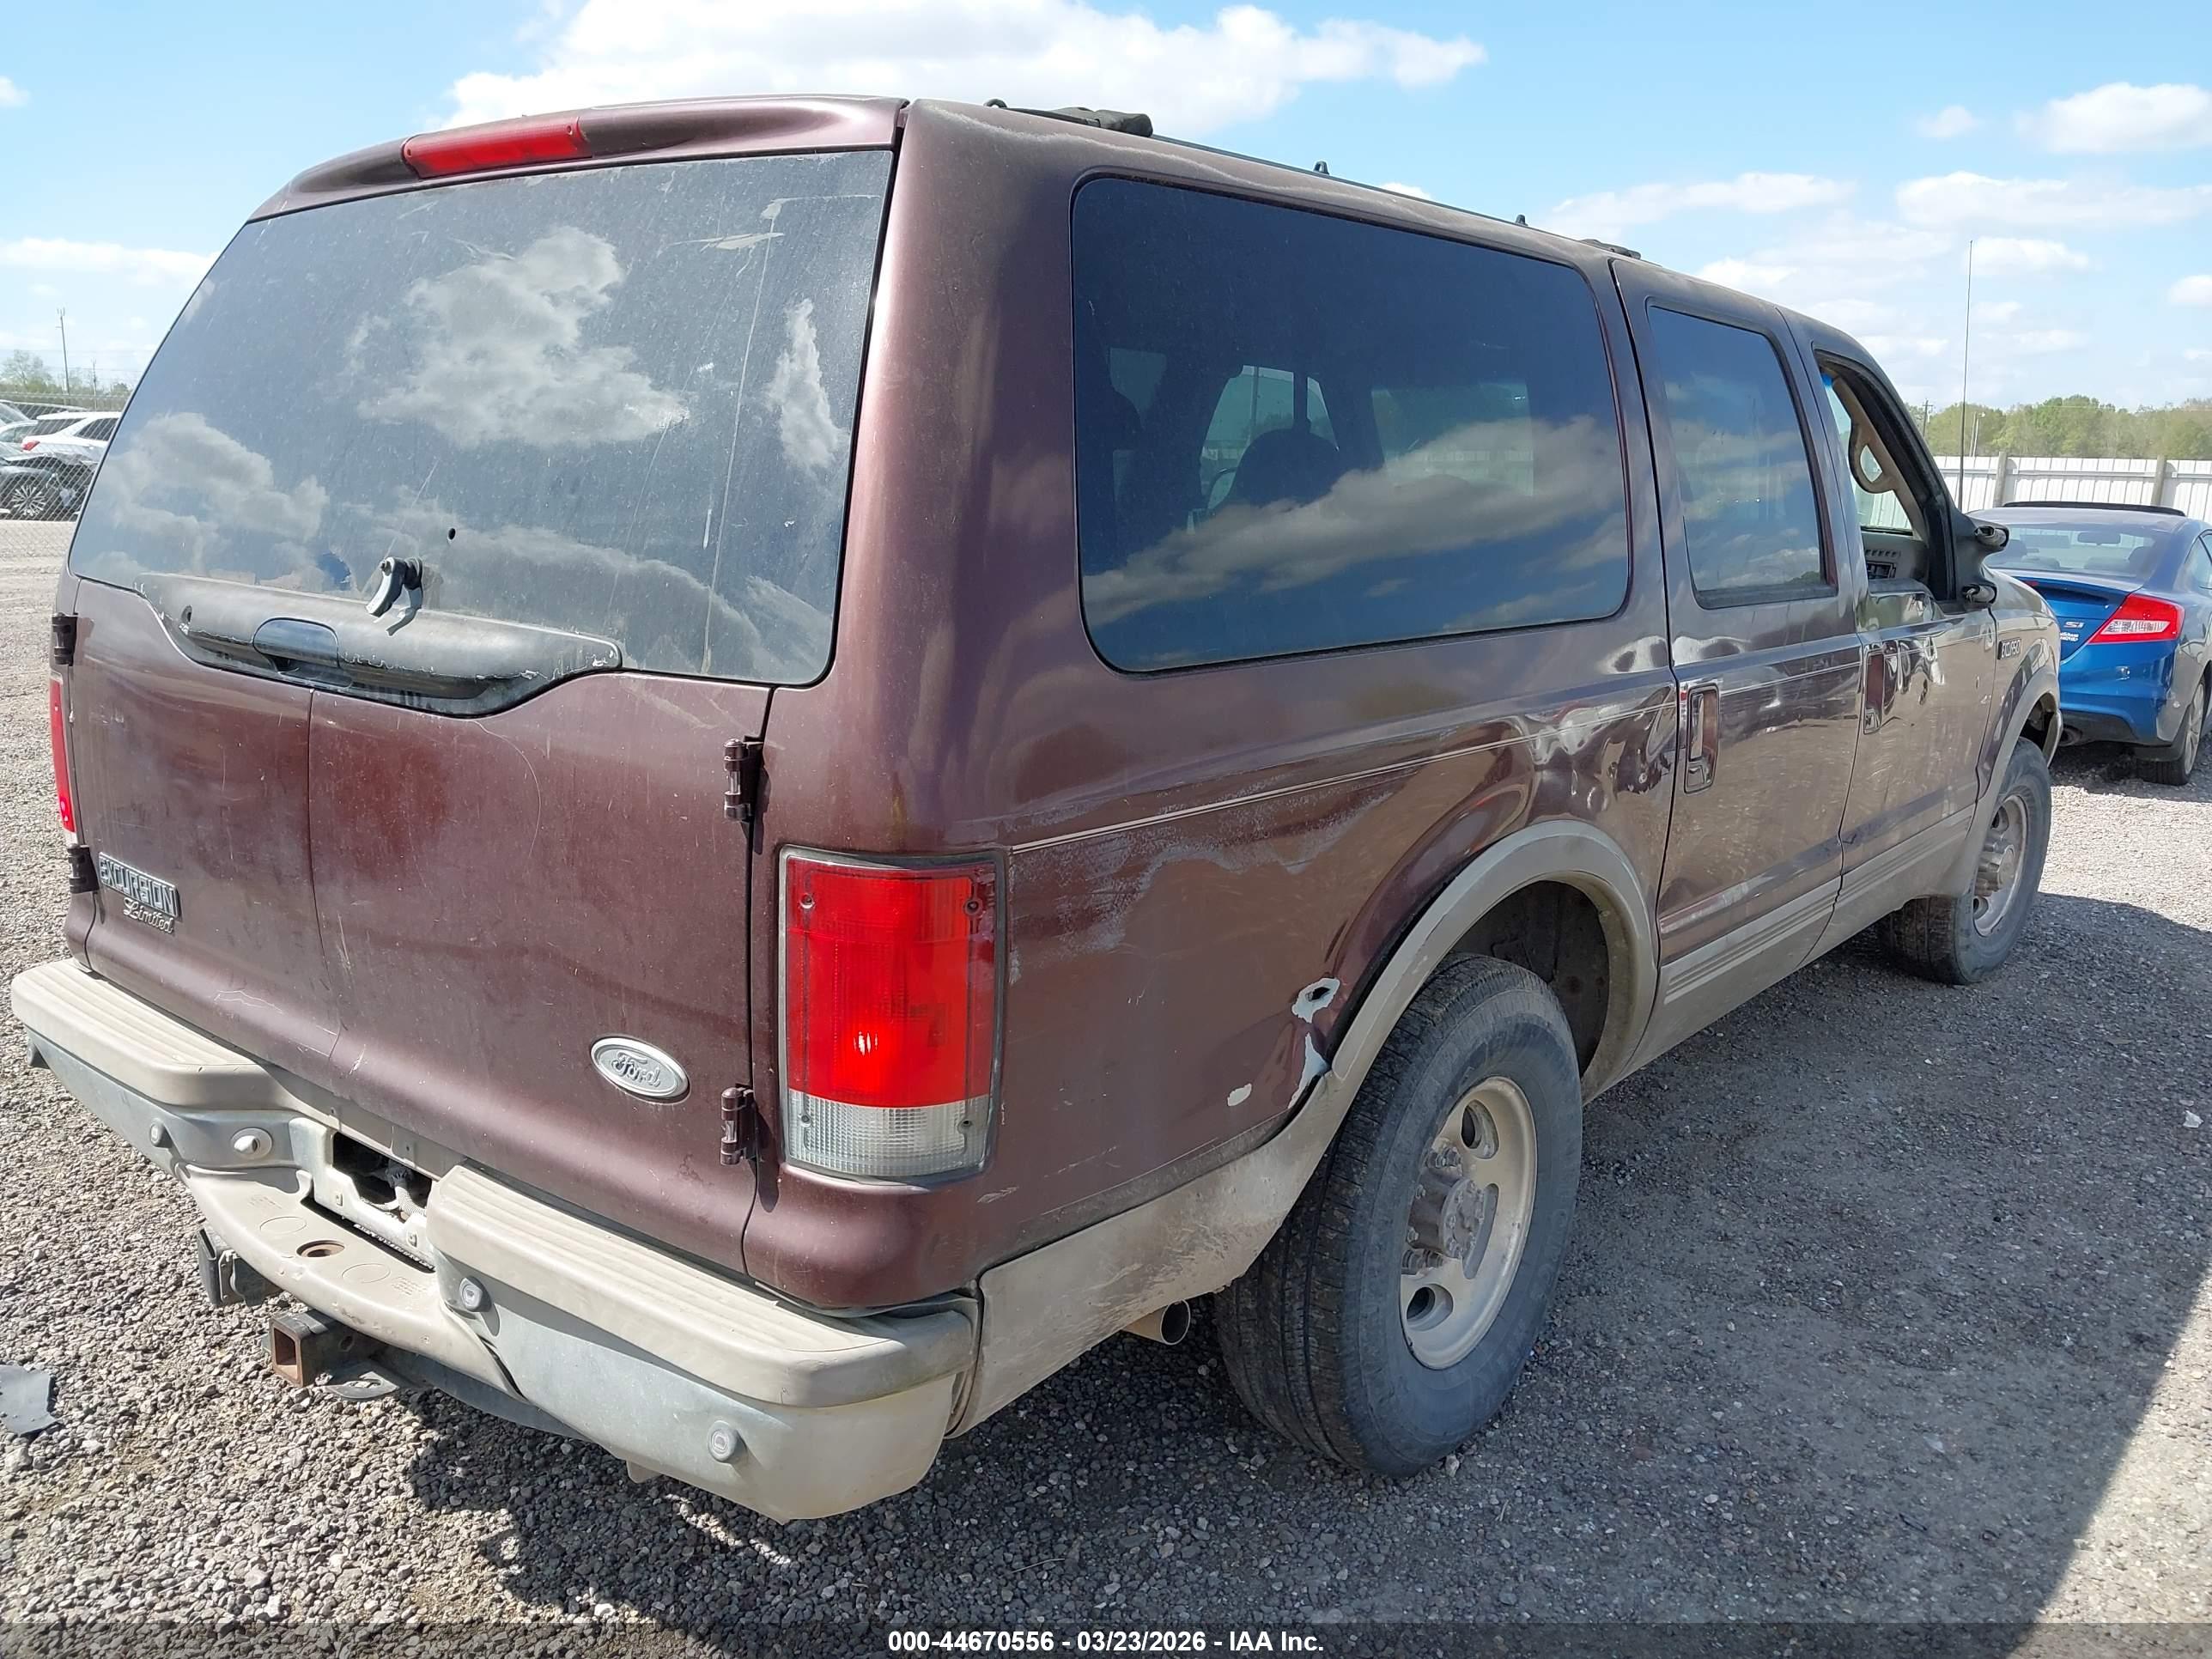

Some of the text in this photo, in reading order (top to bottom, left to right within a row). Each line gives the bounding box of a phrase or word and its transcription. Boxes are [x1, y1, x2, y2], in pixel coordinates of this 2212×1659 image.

[99, 856, 178, 917] EXCURSION
[123, 897, 175, 933] Limited
[611, 1050, 661, 1087] Ford
